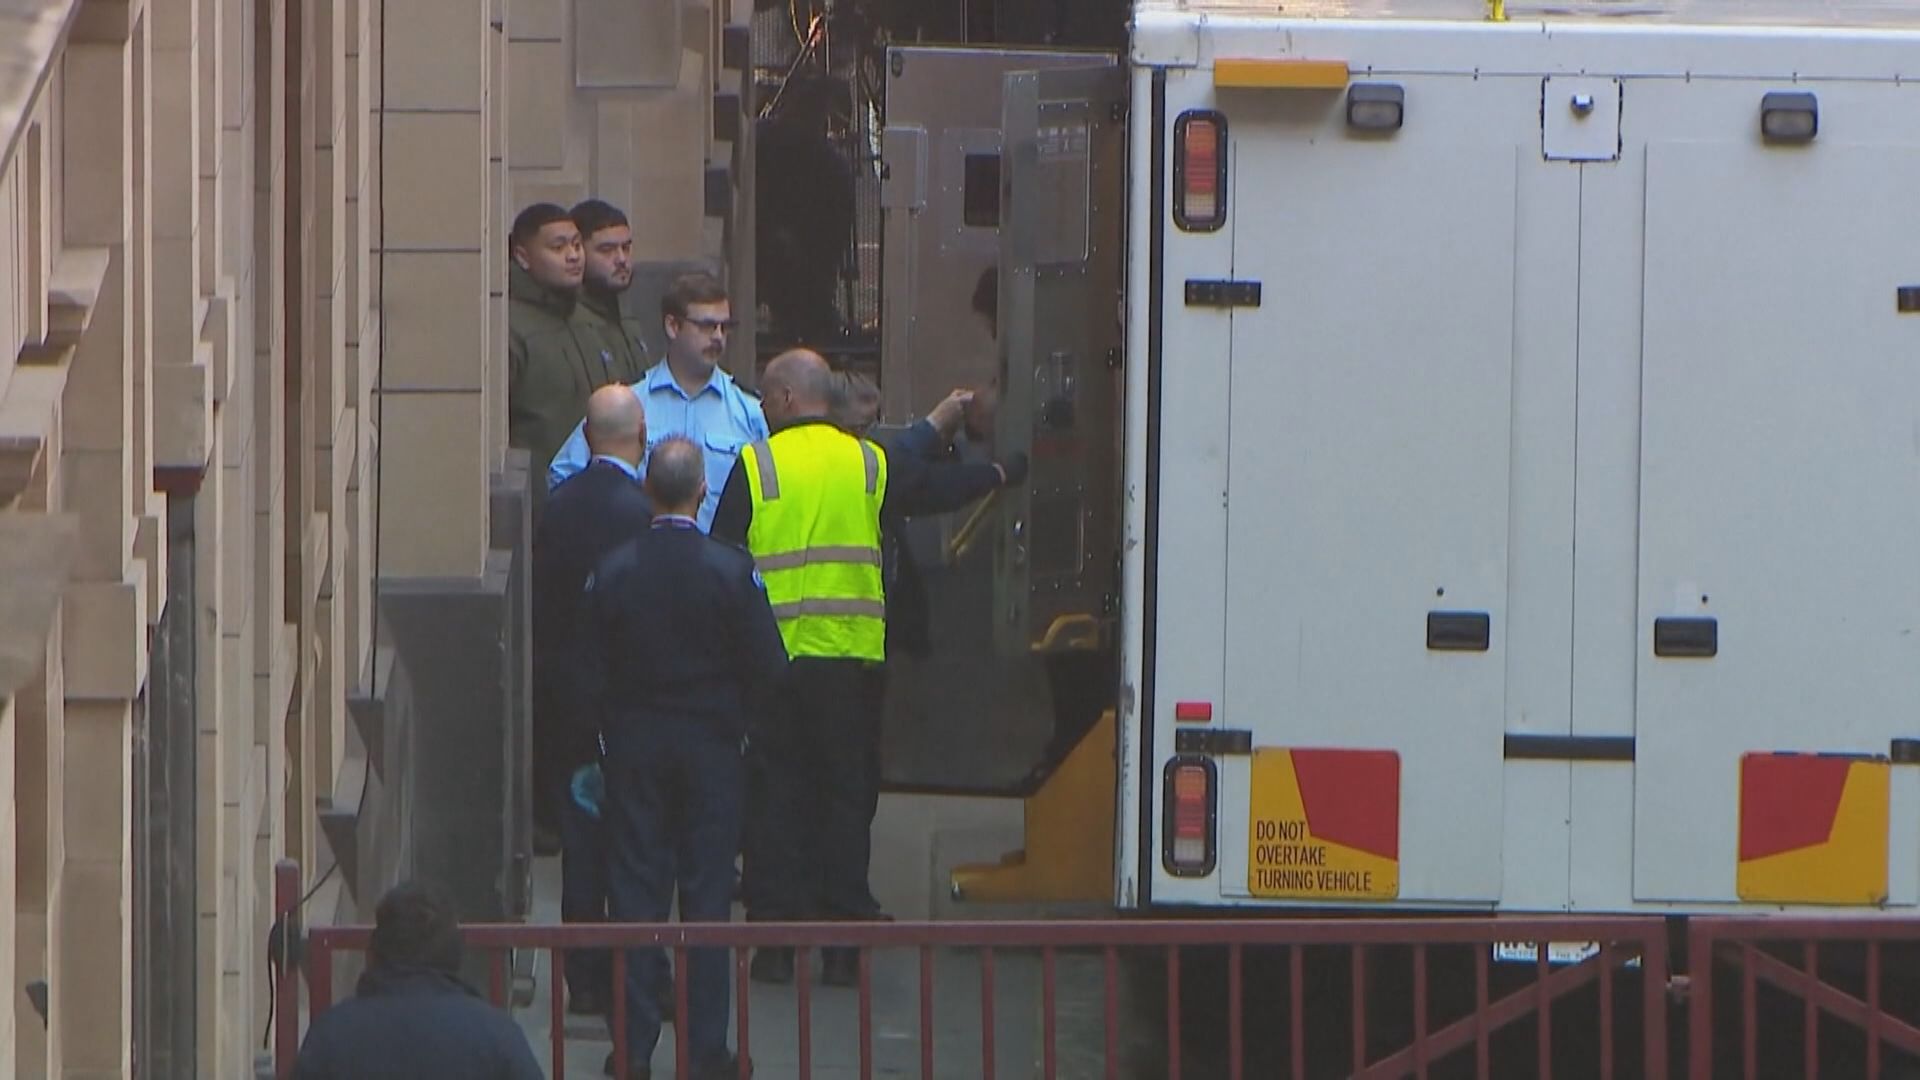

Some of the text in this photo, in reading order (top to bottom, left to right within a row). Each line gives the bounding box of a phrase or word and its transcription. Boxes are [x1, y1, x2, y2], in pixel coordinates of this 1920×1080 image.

[1256, 820, 1305, 841] DO NOT
[1256, 845, 1326, 867] OVERTAKE
[1256, 869, 1372, 892] TURNING VEHICLE
